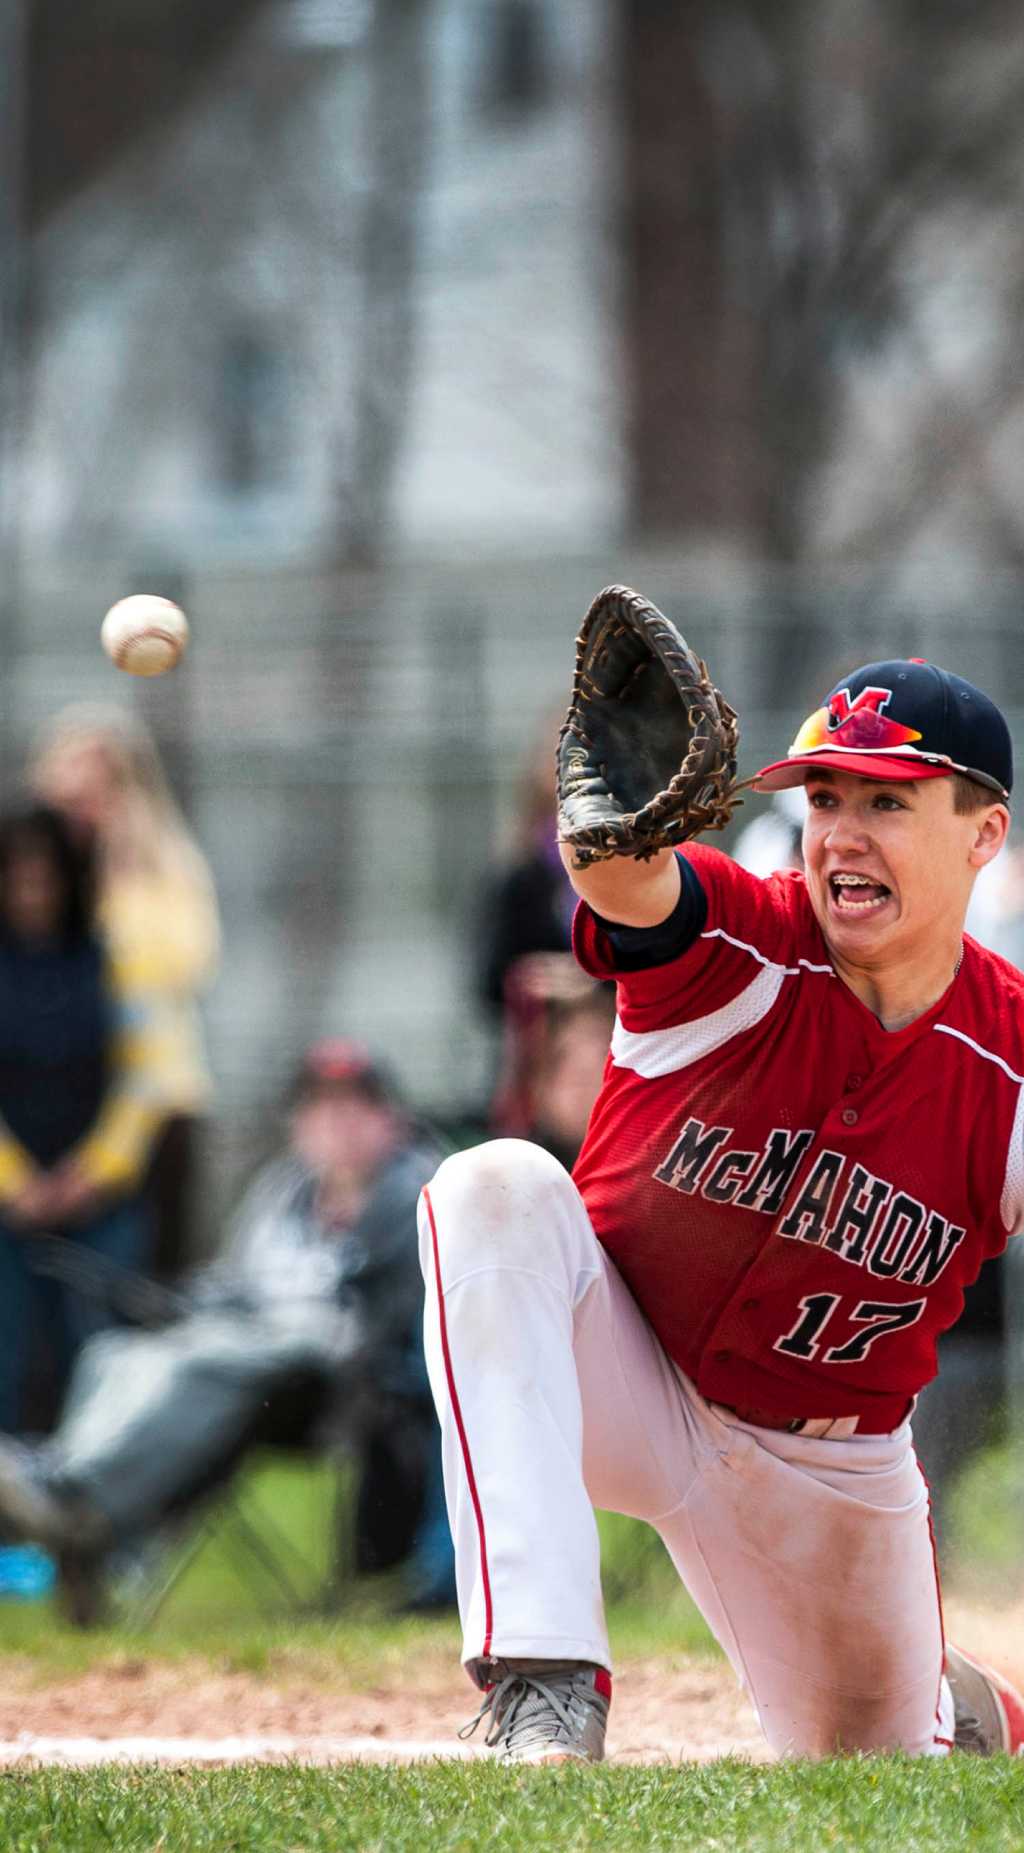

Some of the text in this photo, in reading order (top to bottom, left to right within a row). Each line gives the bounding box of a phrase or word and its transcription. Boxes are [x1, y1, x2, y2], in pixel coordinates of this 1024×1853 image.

[828, 686, 892, 733] M
[652, 1117, 966, 1287] McMAHON
[773, 1292, 927, 1364] 17
